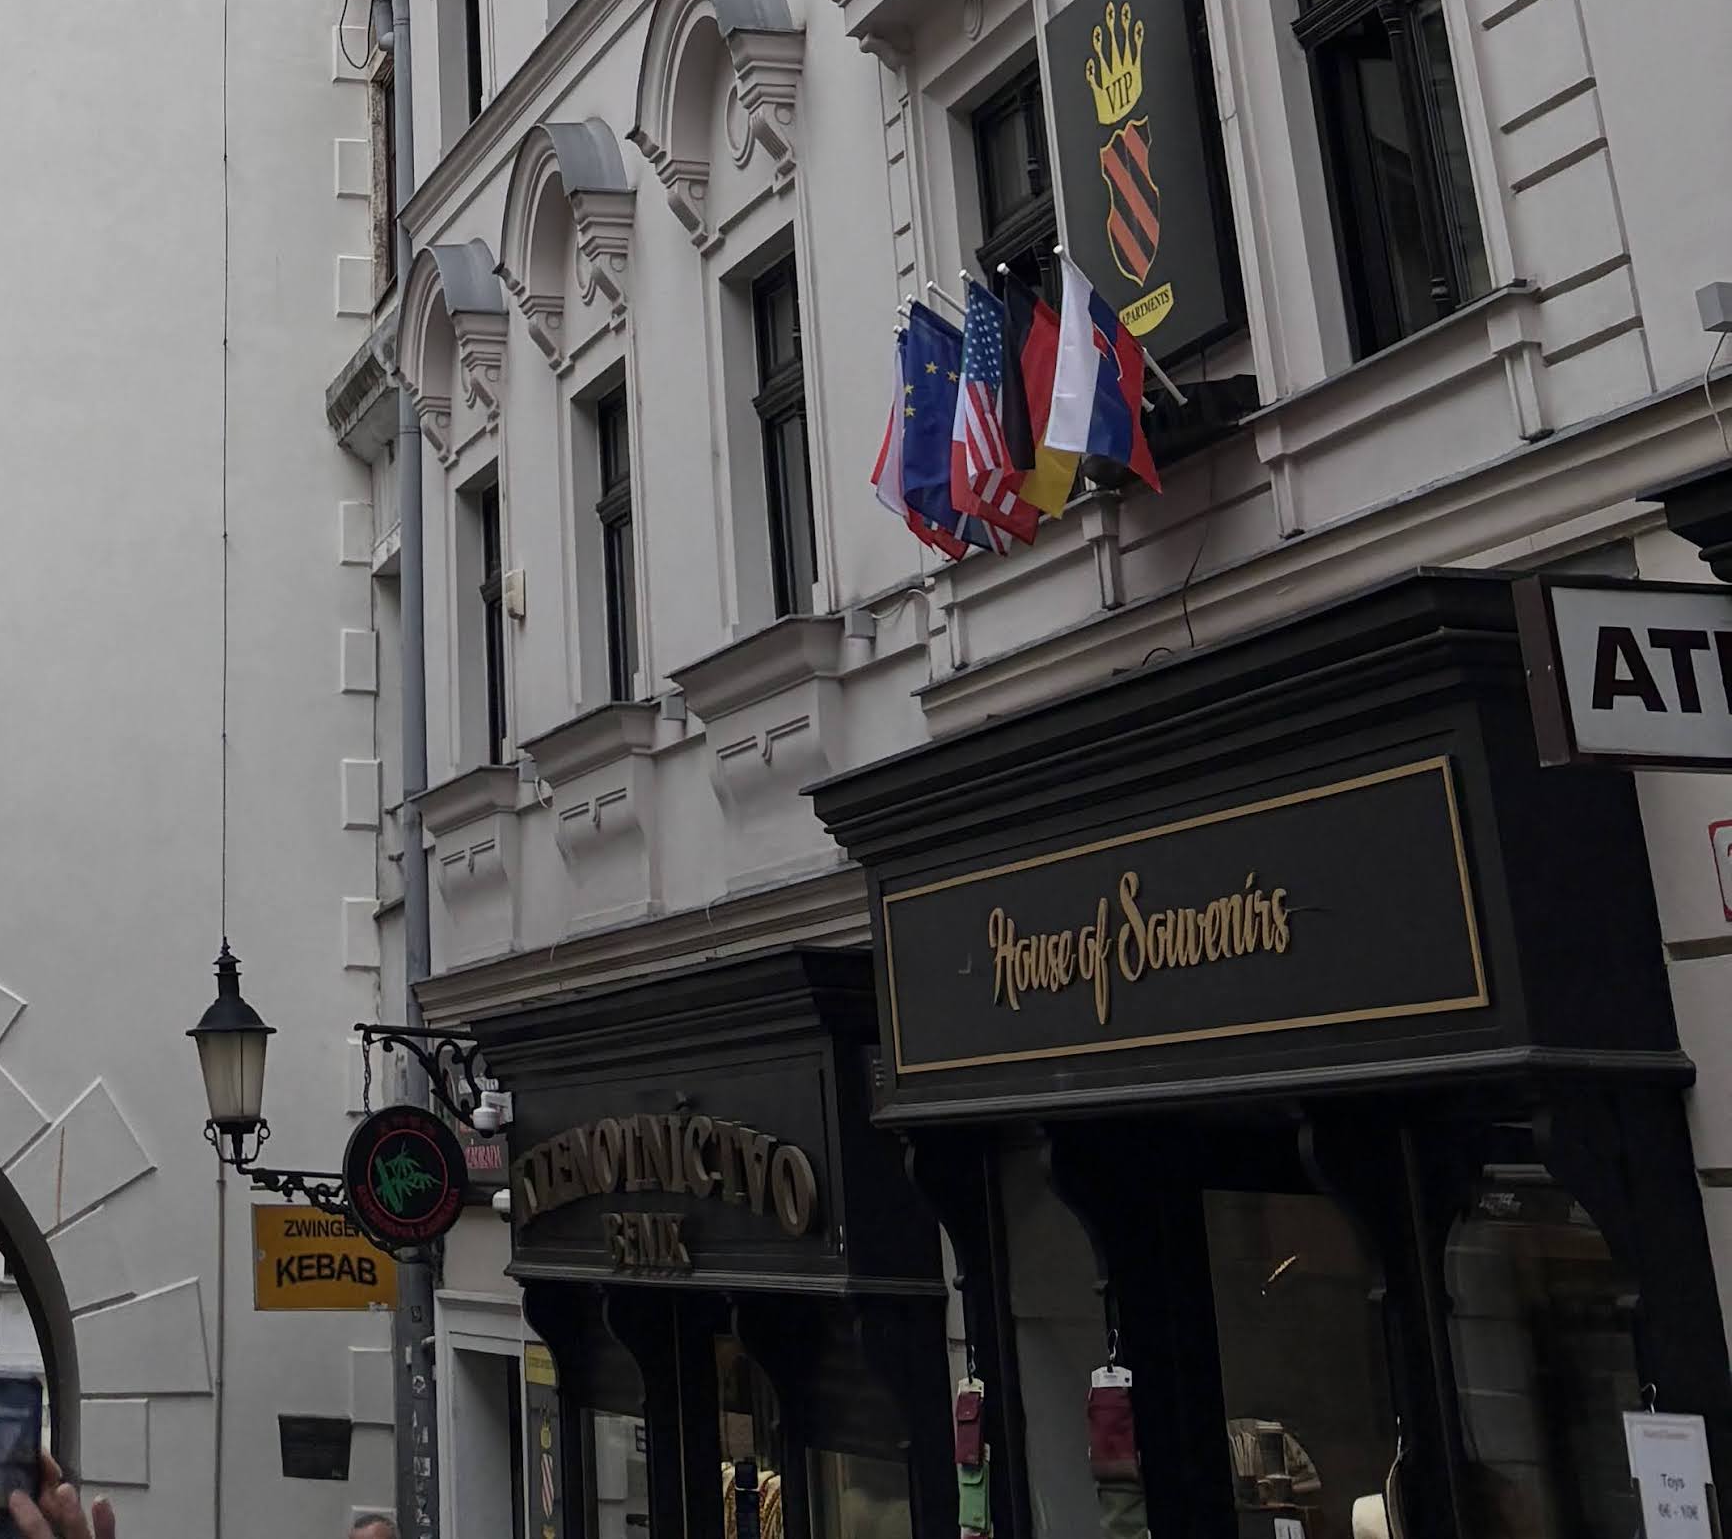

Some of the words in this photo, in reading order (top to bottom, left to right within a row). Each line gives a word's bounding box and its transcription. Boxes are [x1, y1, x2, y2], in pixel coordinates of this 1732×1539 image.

[1105, 71, 1132, 114] VIP
[1591, 625, 1732, 716] AT
[988, 907, 1076, 1011] House
[1078, 897, 1111, 1025] of
[1117, 871, 1291, 983] Souvenirs
[284, 1219, 360, 1238] ZWINGE
[275, 1253, 378, 1288] KEBAB
[1660, 1473, 1685, 1492] Toys
